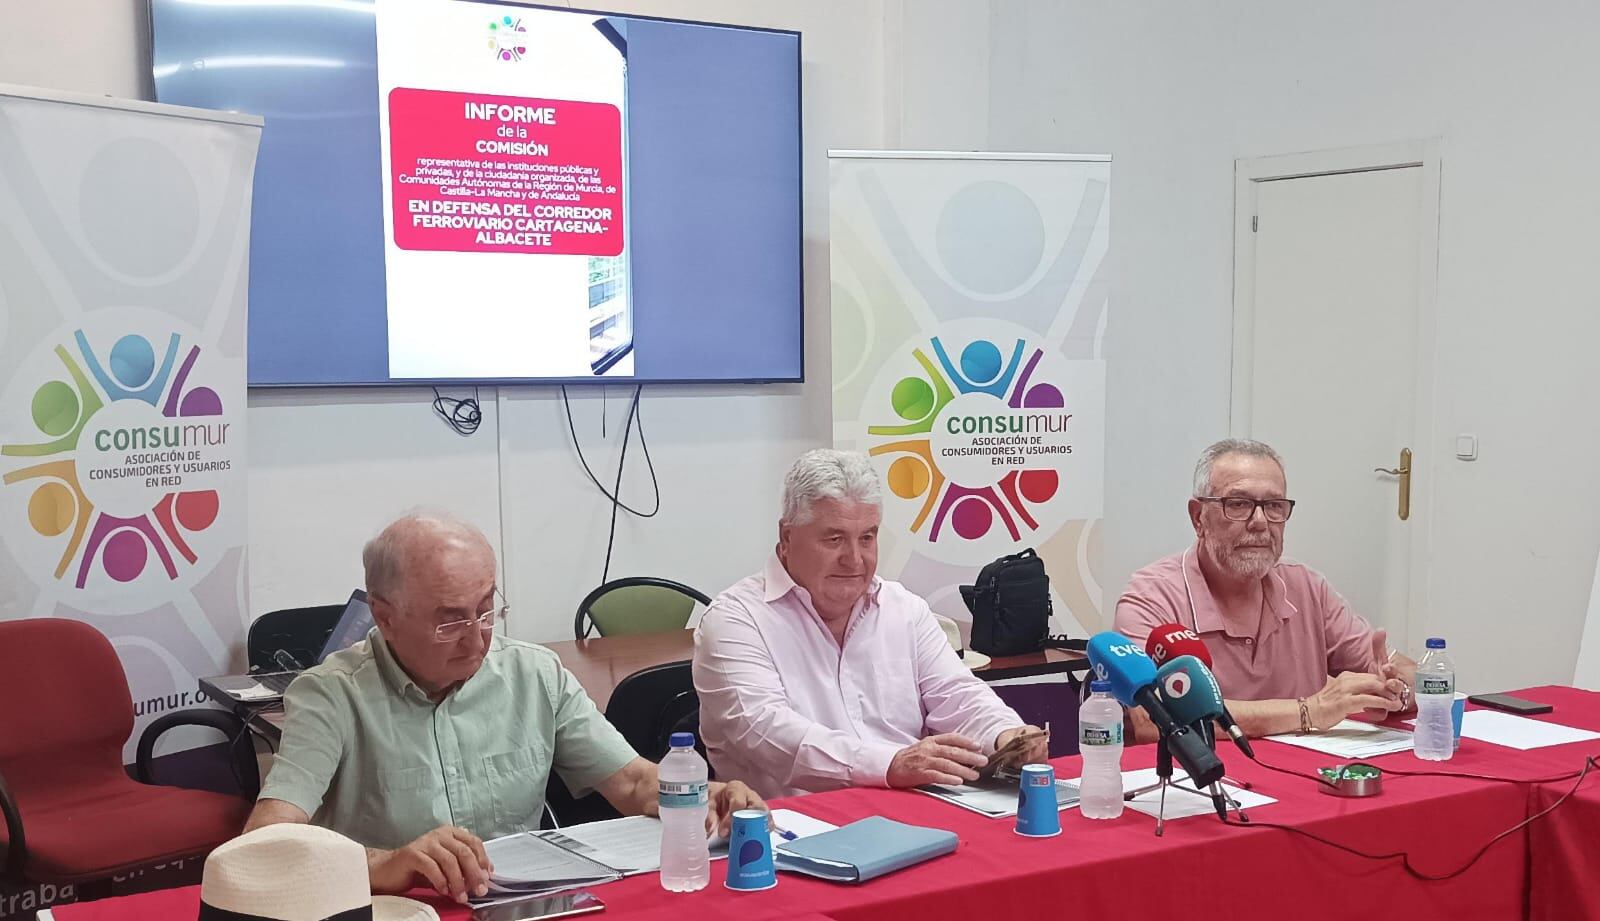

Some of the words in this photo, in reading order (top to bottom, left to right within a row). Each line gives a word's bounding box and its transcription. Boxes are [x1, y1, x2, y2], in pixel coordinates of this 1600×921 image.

[465, 102, 556, 125] INFORME
[497, 124, 514, 137] de
[516, 125, 527, 138] la
[476, 140, 549, 156] COMISIÓN
[417, 158, 480, 168] representativa
[481, 160, 493, 169] de
[494, 161, 506, 170] las
[507, 162, 558, 172] instituciones
[560, 165, 593, 175] públicas
[399, 174, 460, 186] Comunidades
[461, 178, 510, 188] Autónomas
[512, 181, 523, 189] de
[524, 181, 532, 189] la
[533, 181, 562, 192] Región
[563, 183, 574, 191] de
[606, 185, 616, 193] de
[455, 170, 461, 178] y
[463, 170, 474, 178] de
[476, 170, 483, 178] la
[578, 175, 589, 183] de
[590, 176, 601, 184] las
[487, 188, 520, 197] Mancha
[528, 191, 539, 199] de
[408, 200, 430, 213] EN
[432, 200, 501, 216] DEFENSA
[503, 203, 531, 218] DEL
[533, 205, 612, 220] CORREDOR
[413, 214, 513, 230] FERROVIARIO
[515, 219, 609, 234] CARTAGENA-
[475, 231, 552, 246] ALBACETE
[947, 414, 1072, 434] consumur
[95, 423, 230, 452] consumur
[972, 435, 1028, 446] ASOCIACIÓN
[1030, 436, 1042, 445] DE
[124, 450, 185, 465] ASOCIACIÓN
[187, 450, 201, 461] DE
[941, 447, 1016, 457] CONSUMIDORES
[1026, 445, 1072, 455] USUARIOS
[991, 457, 1004, 466] EN
[1006, 456, 1025, 465] RED
[89, 464, 172, 480] CONSUMIDORES
[173, 464, 181, 473] Y
[183, 460, 231, 473] USUARIOS
[145, 477, 159, 488] EN
[161, 476, 182, 487] RED
[1110, 644, 1147, 657] tve
